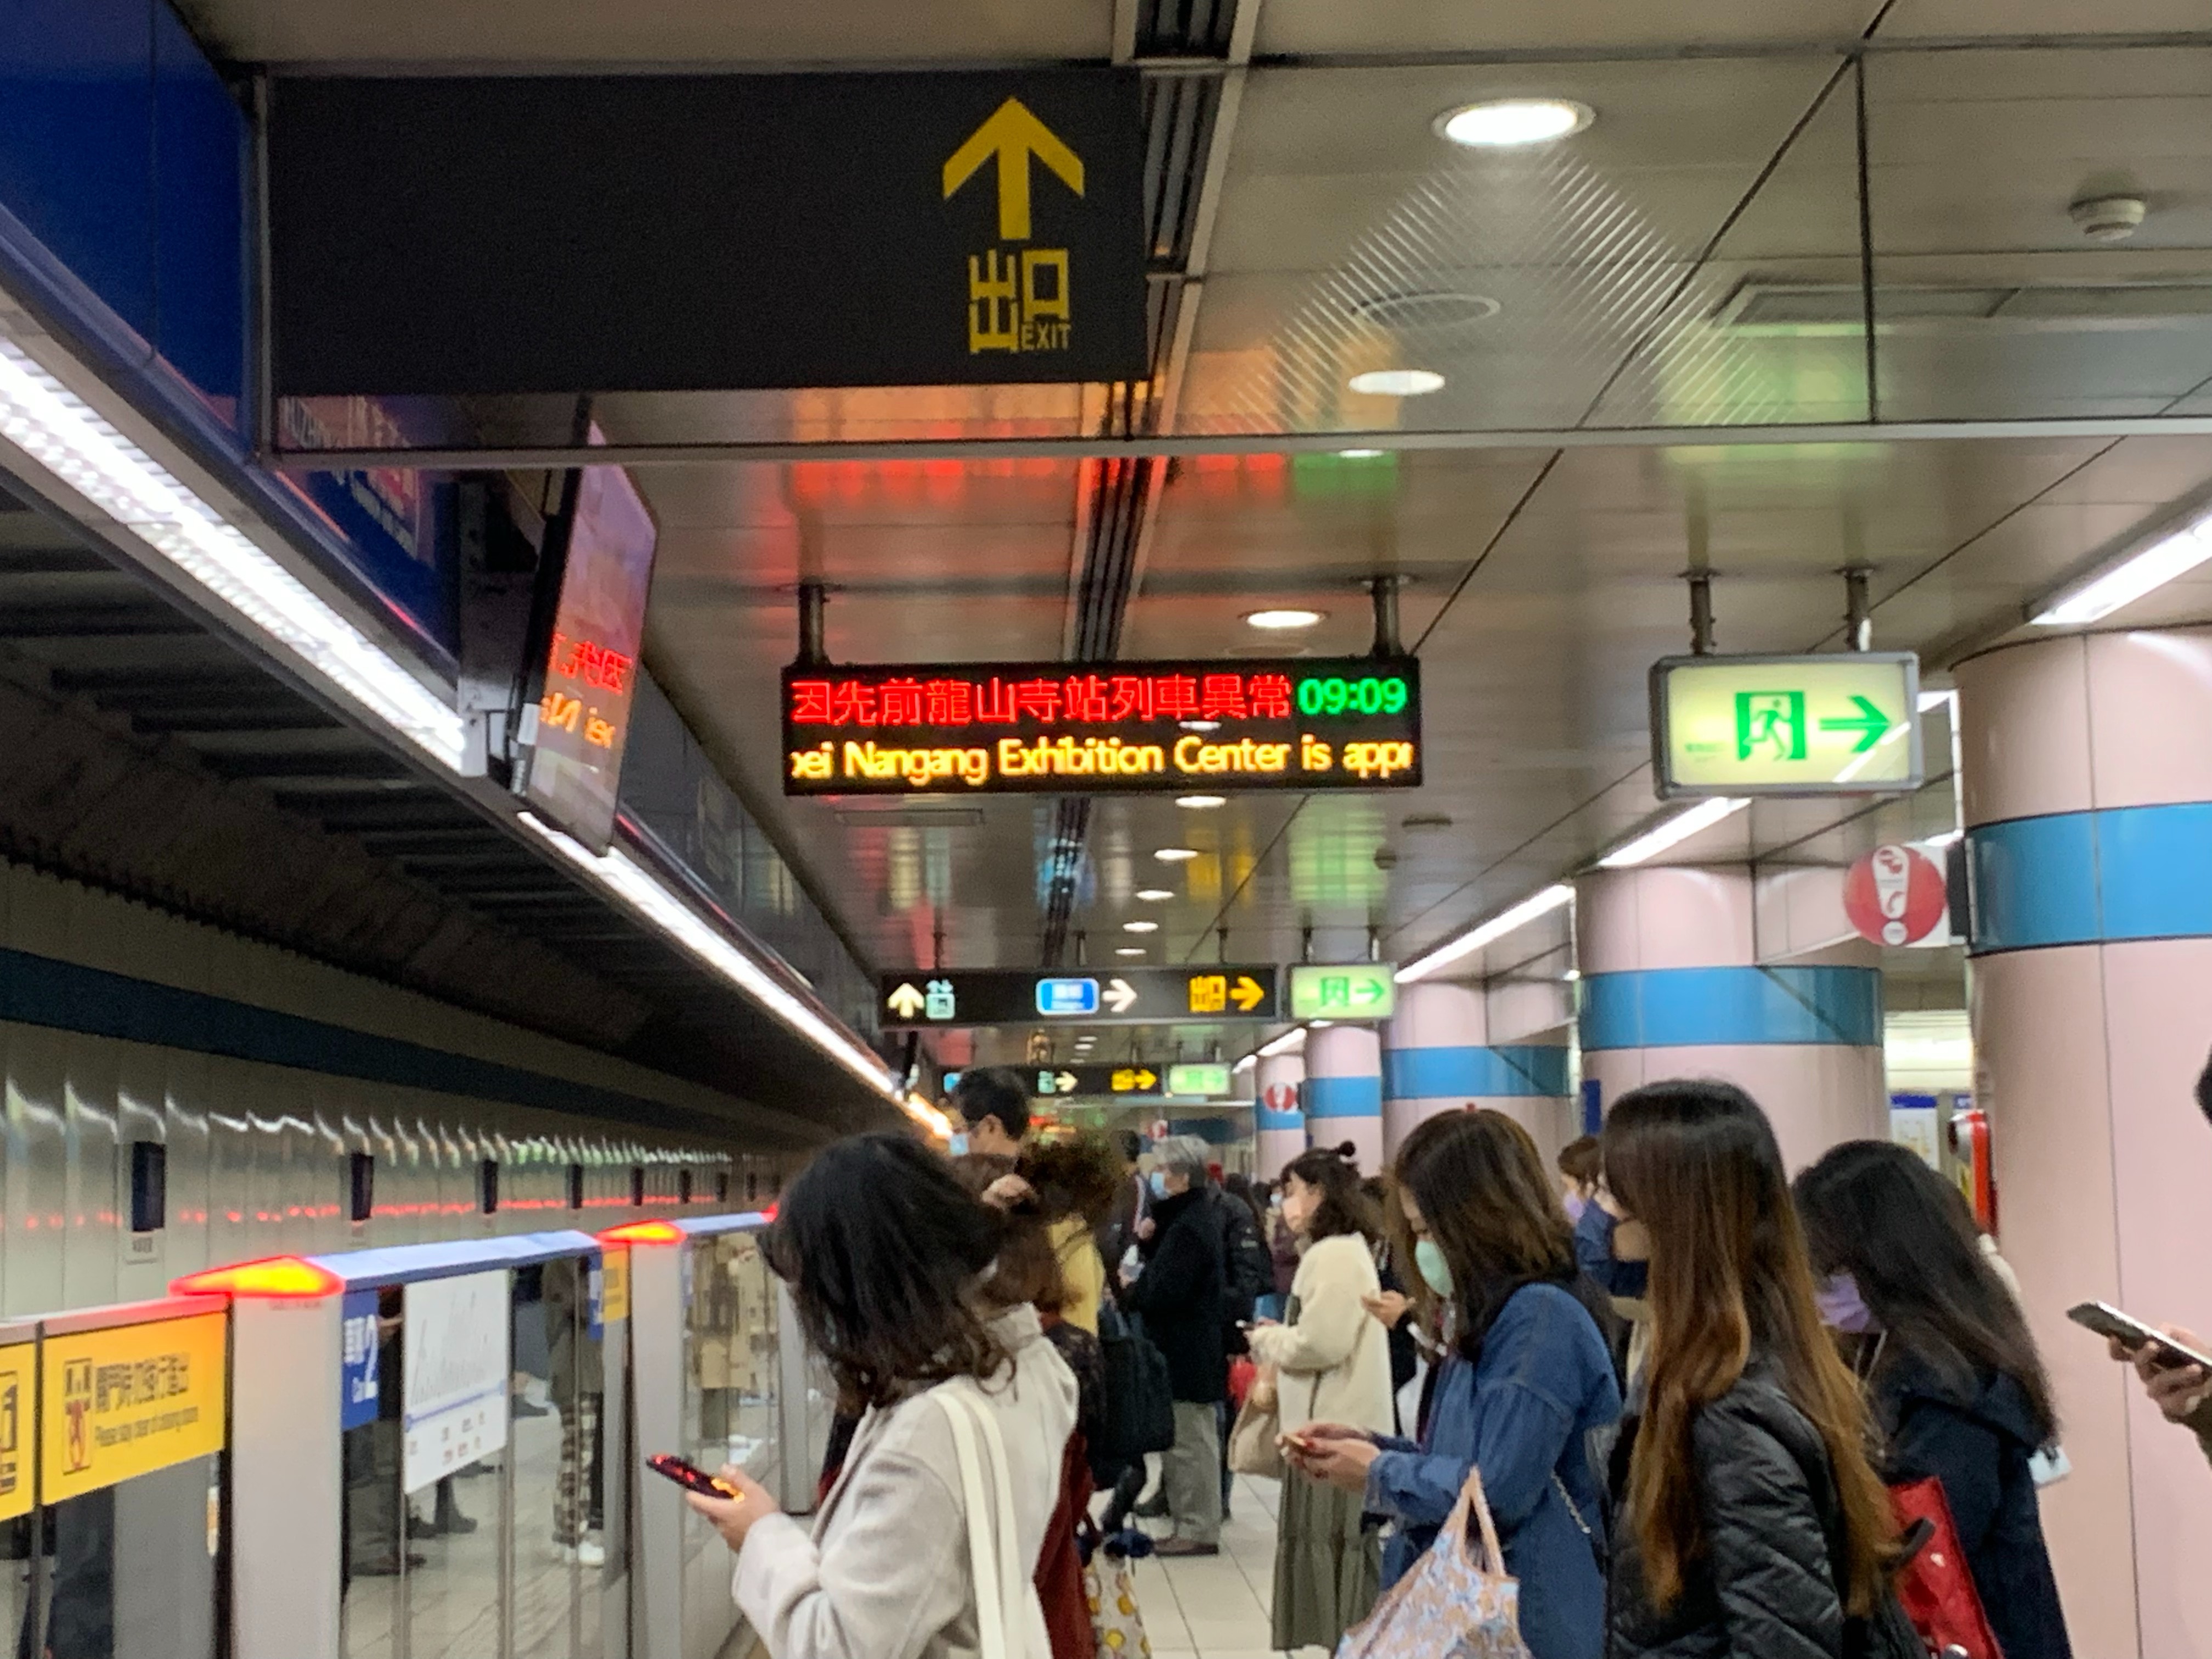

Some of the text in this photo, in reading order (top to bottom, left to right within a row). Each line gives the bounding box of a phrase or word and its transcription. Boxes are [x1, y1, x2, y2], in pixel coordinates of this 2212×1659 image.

[968, 248, 1070, 354] 出口
[1020, 322, 1072, 351] EXIT
[791, 674, 1293, 726] 因先前龍山寺站列車異常
[1297, 678, 1408, 715] 09:09
[843, 740, 989, 786] Nangang
[998, 736, 1165, 776] Exhibition
[1173, 735, 1292, 774] Center
[1301, 733, 1333, 771] is
